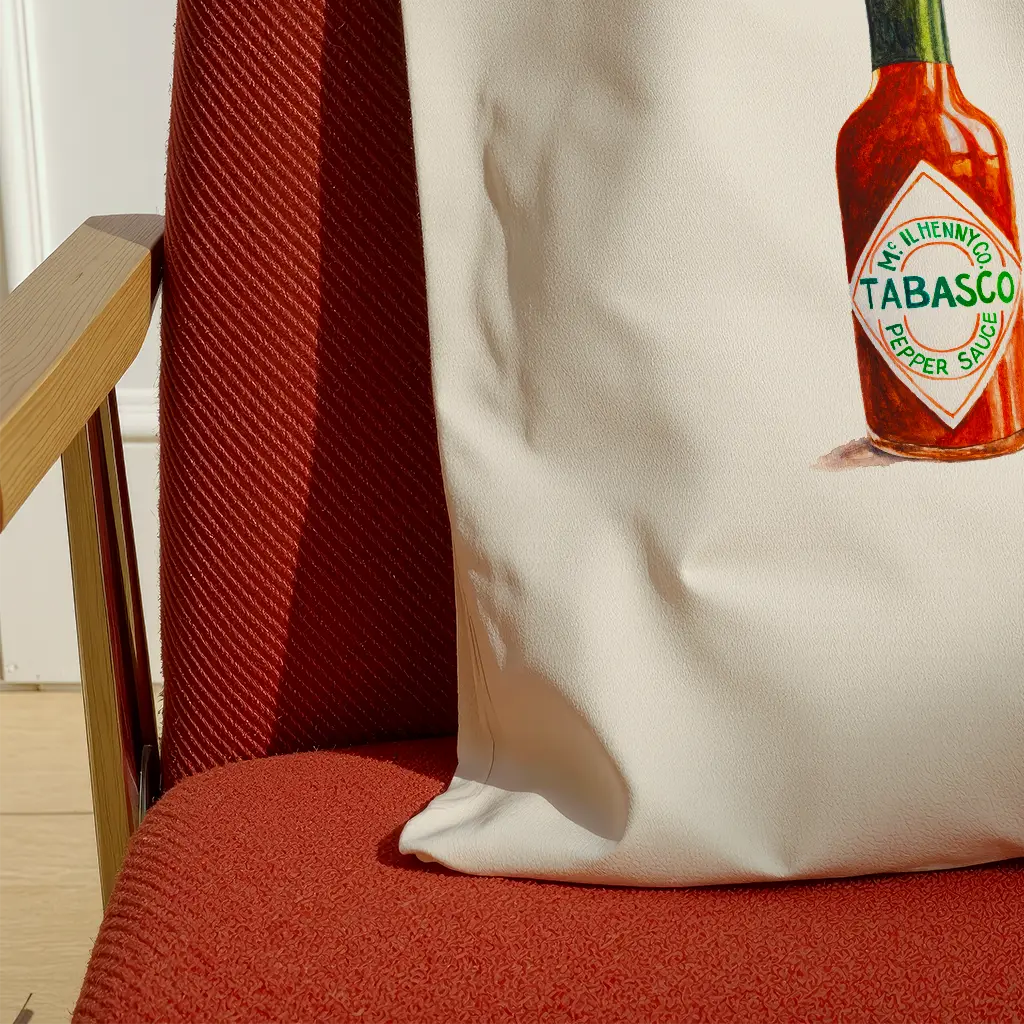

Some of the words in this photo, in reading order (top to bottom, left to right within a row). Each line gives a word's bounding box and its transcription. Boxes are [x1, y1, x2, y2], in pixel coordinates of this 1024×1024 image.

[859, 270, 1015, 310] TABASCO
[885, 323, 949, 375] PEPPER
[957, 312, 998, 370] SAUCE
